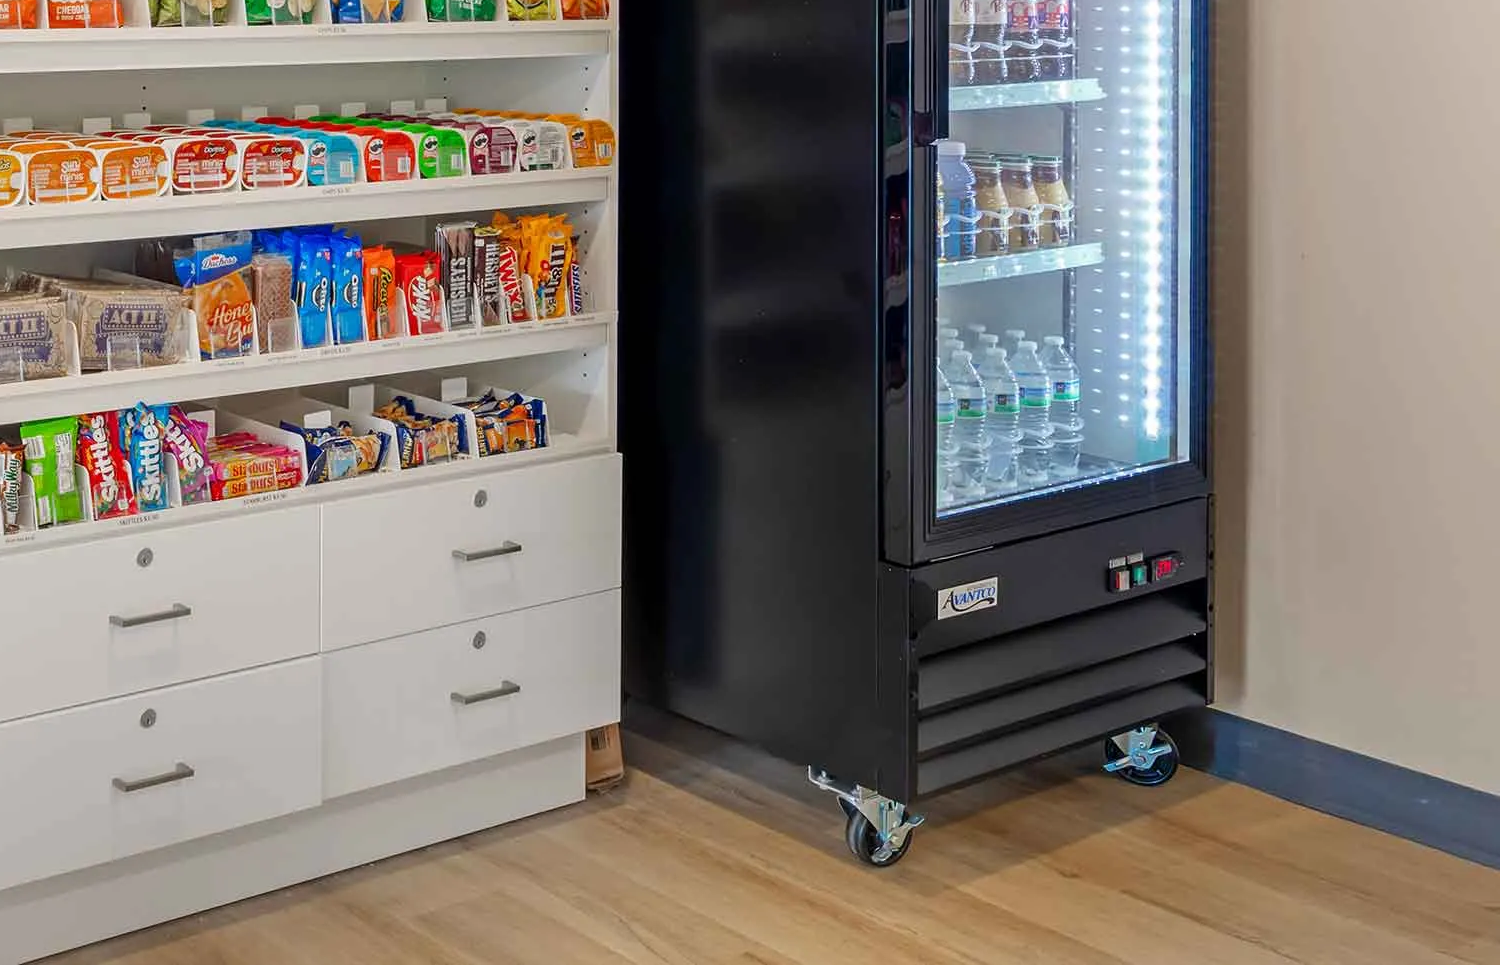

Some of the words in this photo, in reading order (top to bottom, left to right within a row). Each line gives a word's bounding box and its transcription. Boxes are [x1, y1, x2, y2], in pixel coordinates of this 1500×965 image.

[201, 254, 238, 270] Duchess
[320, 277, 328, 312] OREO
[351, 274, 359, 309] OREO
[109, 309, 138, 326] ACT
[476, 426, 487, 456] LANTERS
[91, 415, 118, 503] Skittles
[942, 587, 996, 611] AVANTCO
